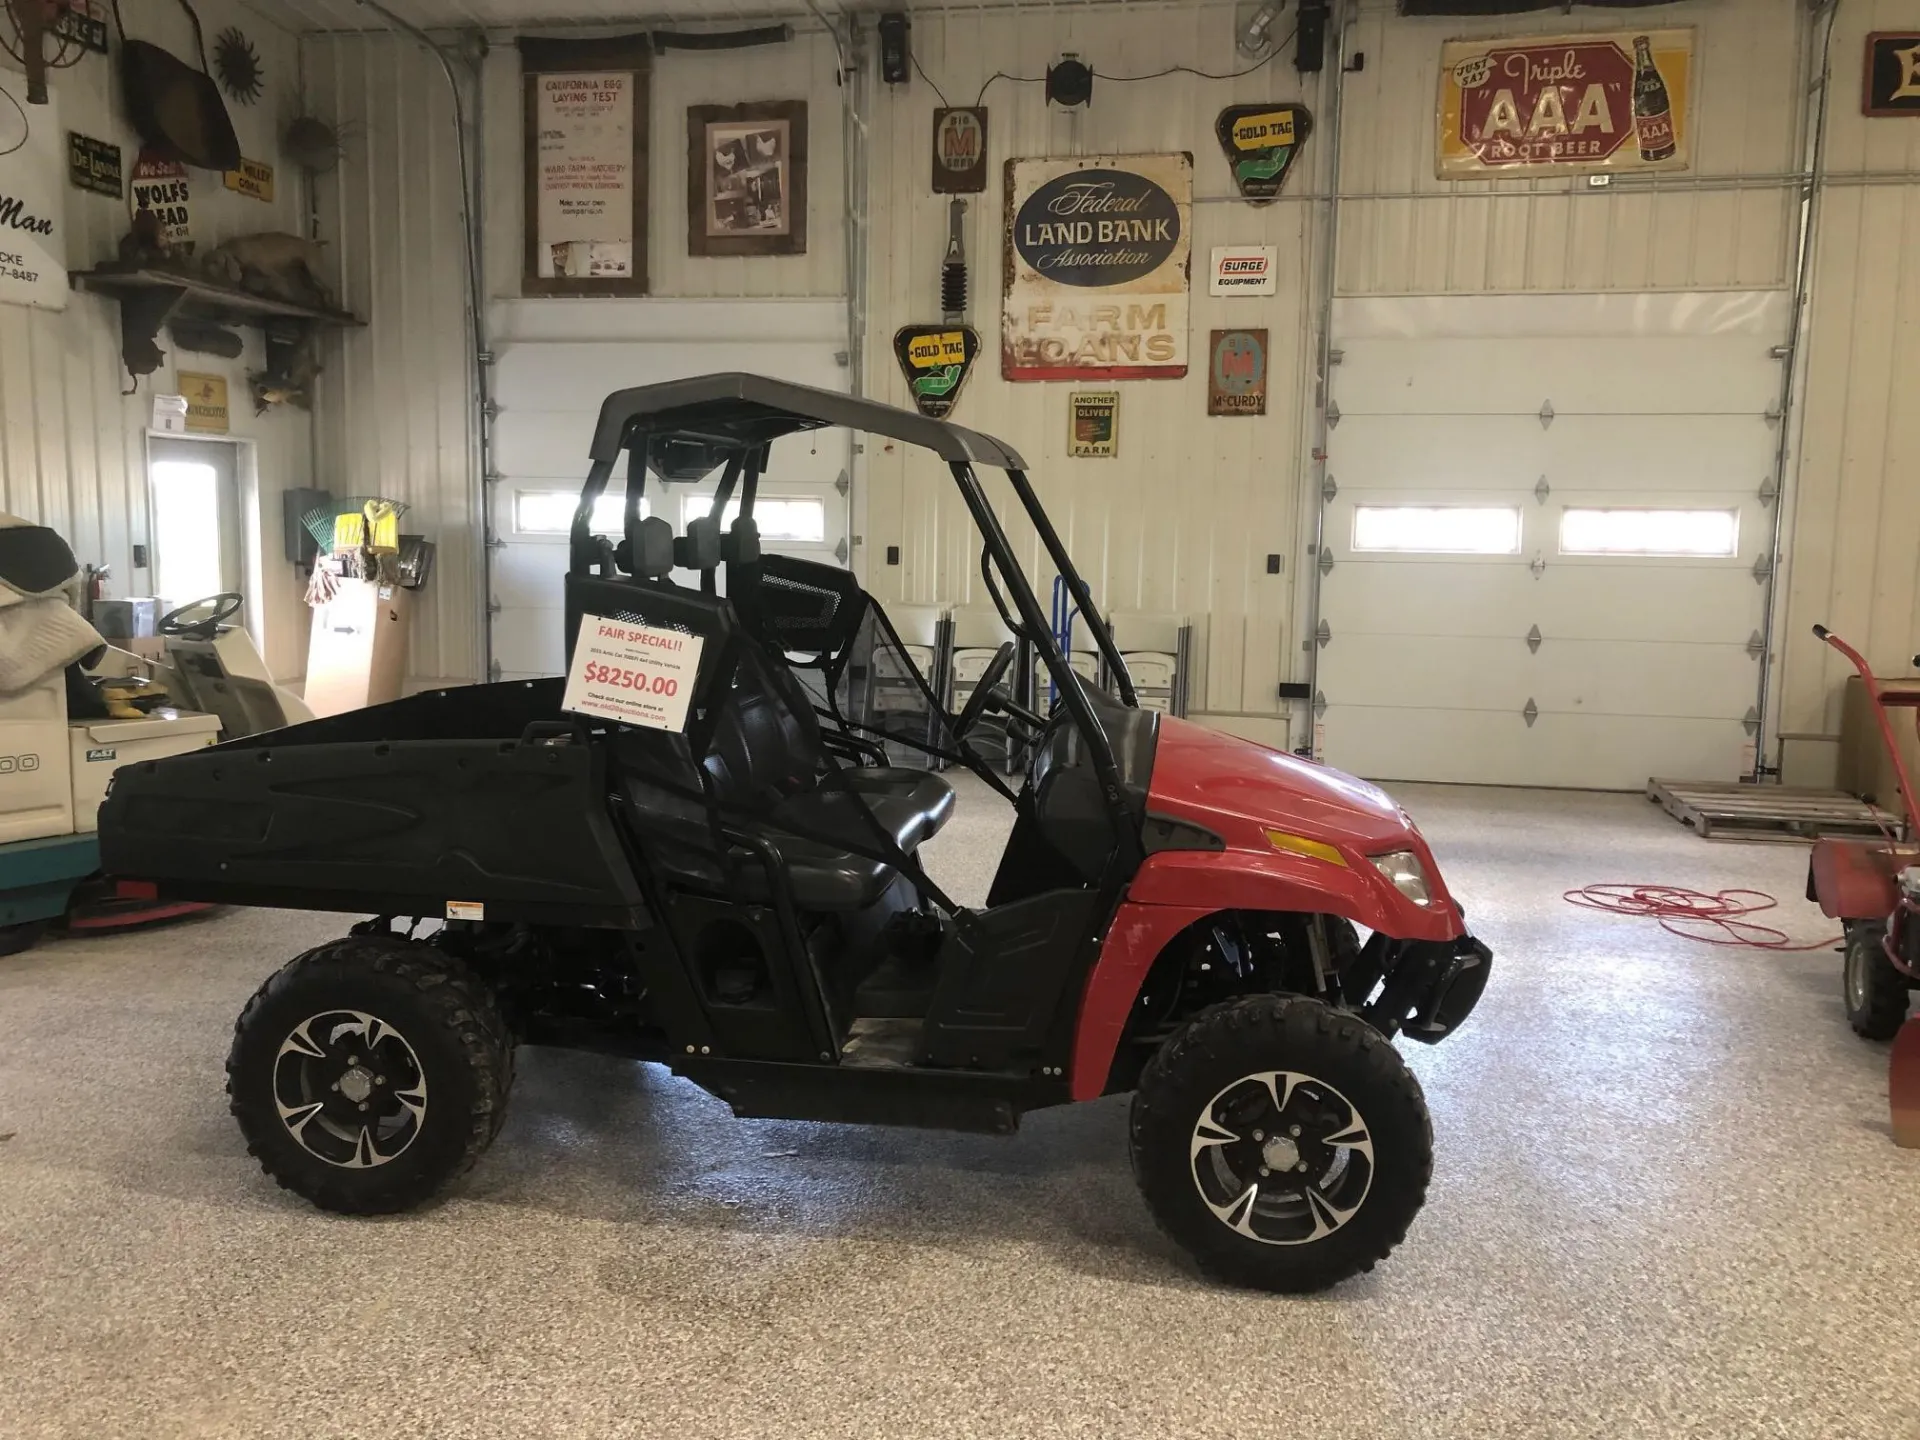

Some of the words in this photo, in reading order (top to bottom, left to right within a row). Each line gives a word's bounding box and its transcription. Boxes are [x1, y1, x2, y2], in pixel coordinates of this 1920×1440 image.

[1456, 57, 1488, 77] JUST
[1504, 50, 1587, 95] Triple
[545, 80, 599, 91] CALIFORNIA
[603, 79, 623, 89] EGG
[1462, 70, 1485, 87] SAY
[552, 93, 587, 103] LAYING
[592, 91, 619, 102] TEST
[1239, 125, 1267, 140] GOLD
[1269, 121, 1292, 135] TAG
[1641, 122, 1670, 139] AAA
[944, 127, 975, 157] M
[1491, 143, 1543, 158] ROOT
[1555, 140, 1601, 155] BEER
[134, 179, 189, 205] WOLF'S
[1047, 182, 1152, 216] Federal
[1025, 221, 1093, 246] LAND
[1098, 218, 1172, 243] BANK
[1037, 248, 1153, 270] Association
[1224, 261, 1264, 271] SURGE
[1218, 278, 1267, 286] EQUIPMENT
[1027, 303, 1167, 333] FARM
[914, 345, 940, 358] GOLD
[942, 342, 963, 355] TAG
[1015, 333, 1177, 364] LOANS
[1074, 396, 1115, 404] ANOTHER
[1078, 409, 1111, 417] OLIVER
[1075, 446, 1110, 454] FARM
[599, 625, 625, 641] FAIR
[627, 631, 684, 652] SPECIAL!!
[584, 660, 678, 697] $8250.00
[587, 692, 604, 700] Check
[625, 700, 642, 708] online
